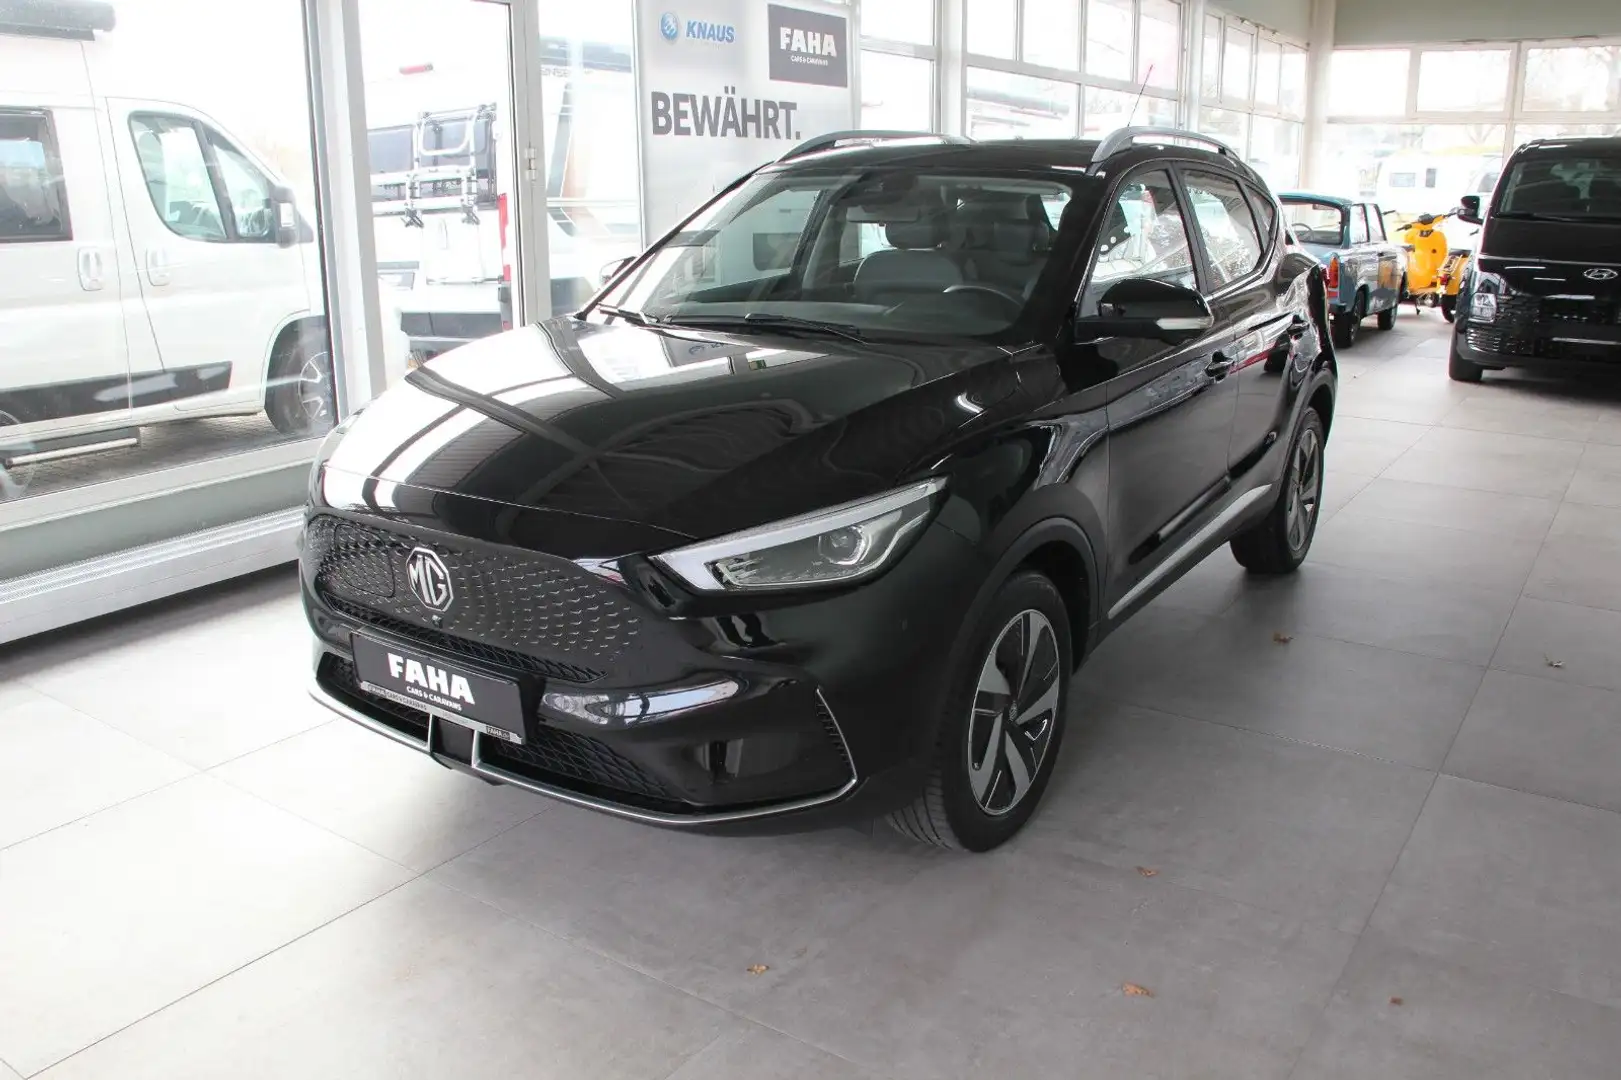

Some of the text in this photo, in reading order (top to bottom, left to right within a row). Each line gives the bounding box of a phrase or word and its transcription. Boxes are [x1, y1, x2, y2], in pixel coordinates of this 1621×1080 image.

[686, 20, 735, 44] KNAUS
[780, 26, 838, 58] FAHA
[791, 55, 803, 63] CARS
[651, 85, 801, 140] BEWÄHRT.
[409, 554, 448, 606] MG
[387, 652, 476, 706] FAHA
[406, 686, 423, 697] CARS
[428, 693, 463, 712] CARAVANS
